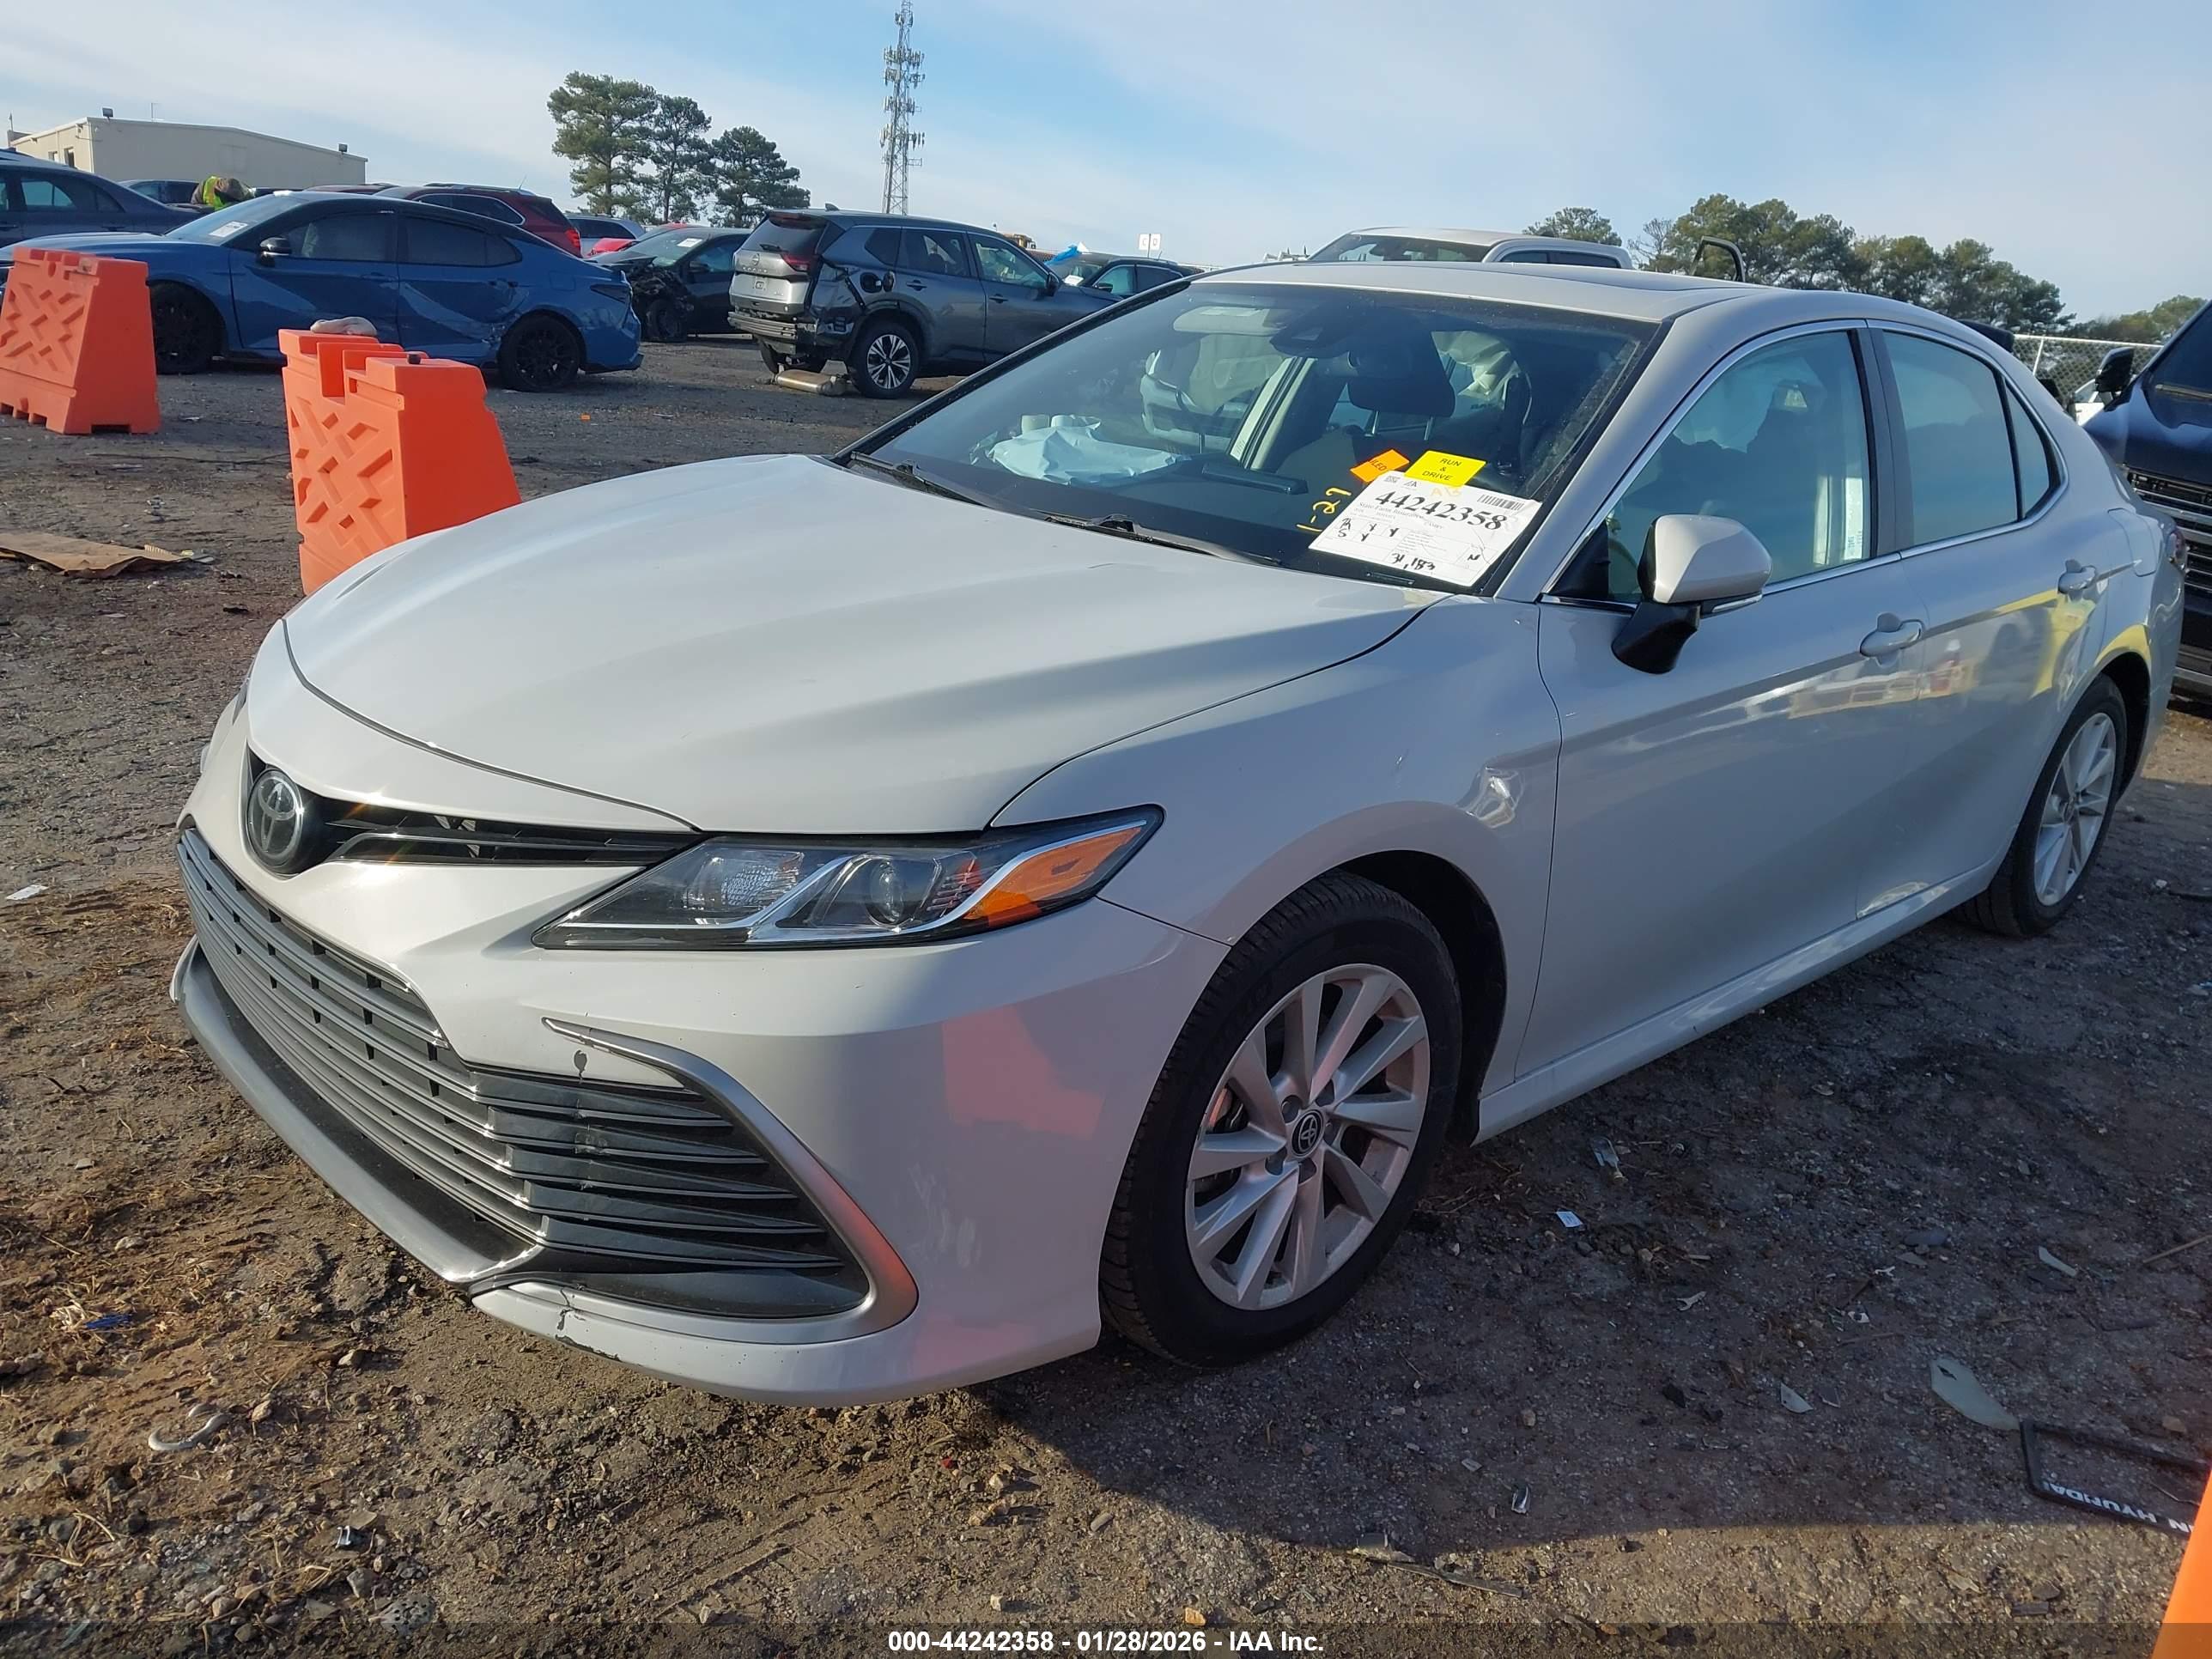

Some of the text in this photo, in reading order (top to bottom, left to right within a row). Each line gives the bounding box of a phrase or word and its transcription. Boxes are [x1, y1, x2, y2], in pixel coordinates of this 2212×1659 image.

[1439, 458, 1462, 466] RUN
[1422, 471, 1453, 481] DRIVE
[1375, 490, 1507, 531] 44242358
[2043, 1481, 2157, 1523] HYUNDAI
